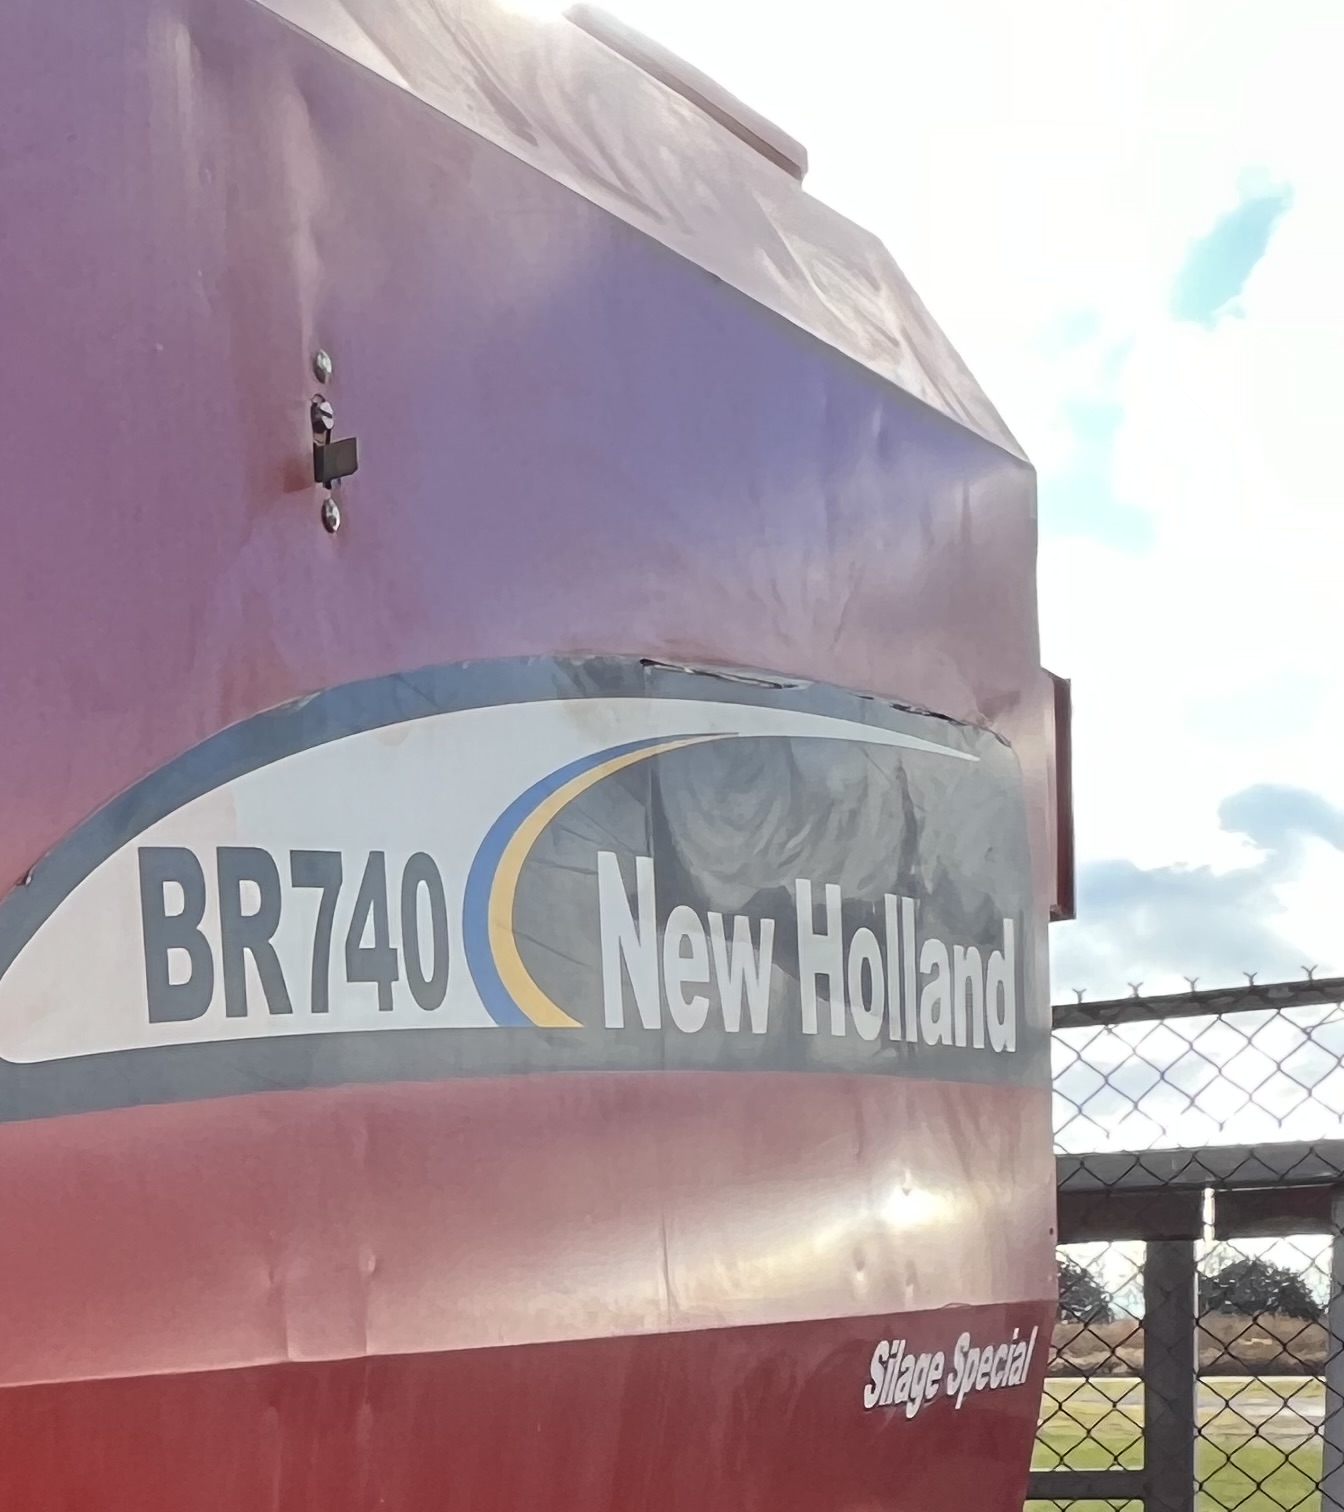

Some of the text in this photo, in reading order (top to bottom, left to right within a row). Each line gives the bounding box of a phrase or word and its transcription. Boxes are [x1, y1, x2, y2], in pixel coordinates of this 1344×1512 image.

[138, 846, 450, 1024] BR740
[596, 850, 1018, 1053] New Holland
[863, 1325, 1039, 1419] Silage Special
